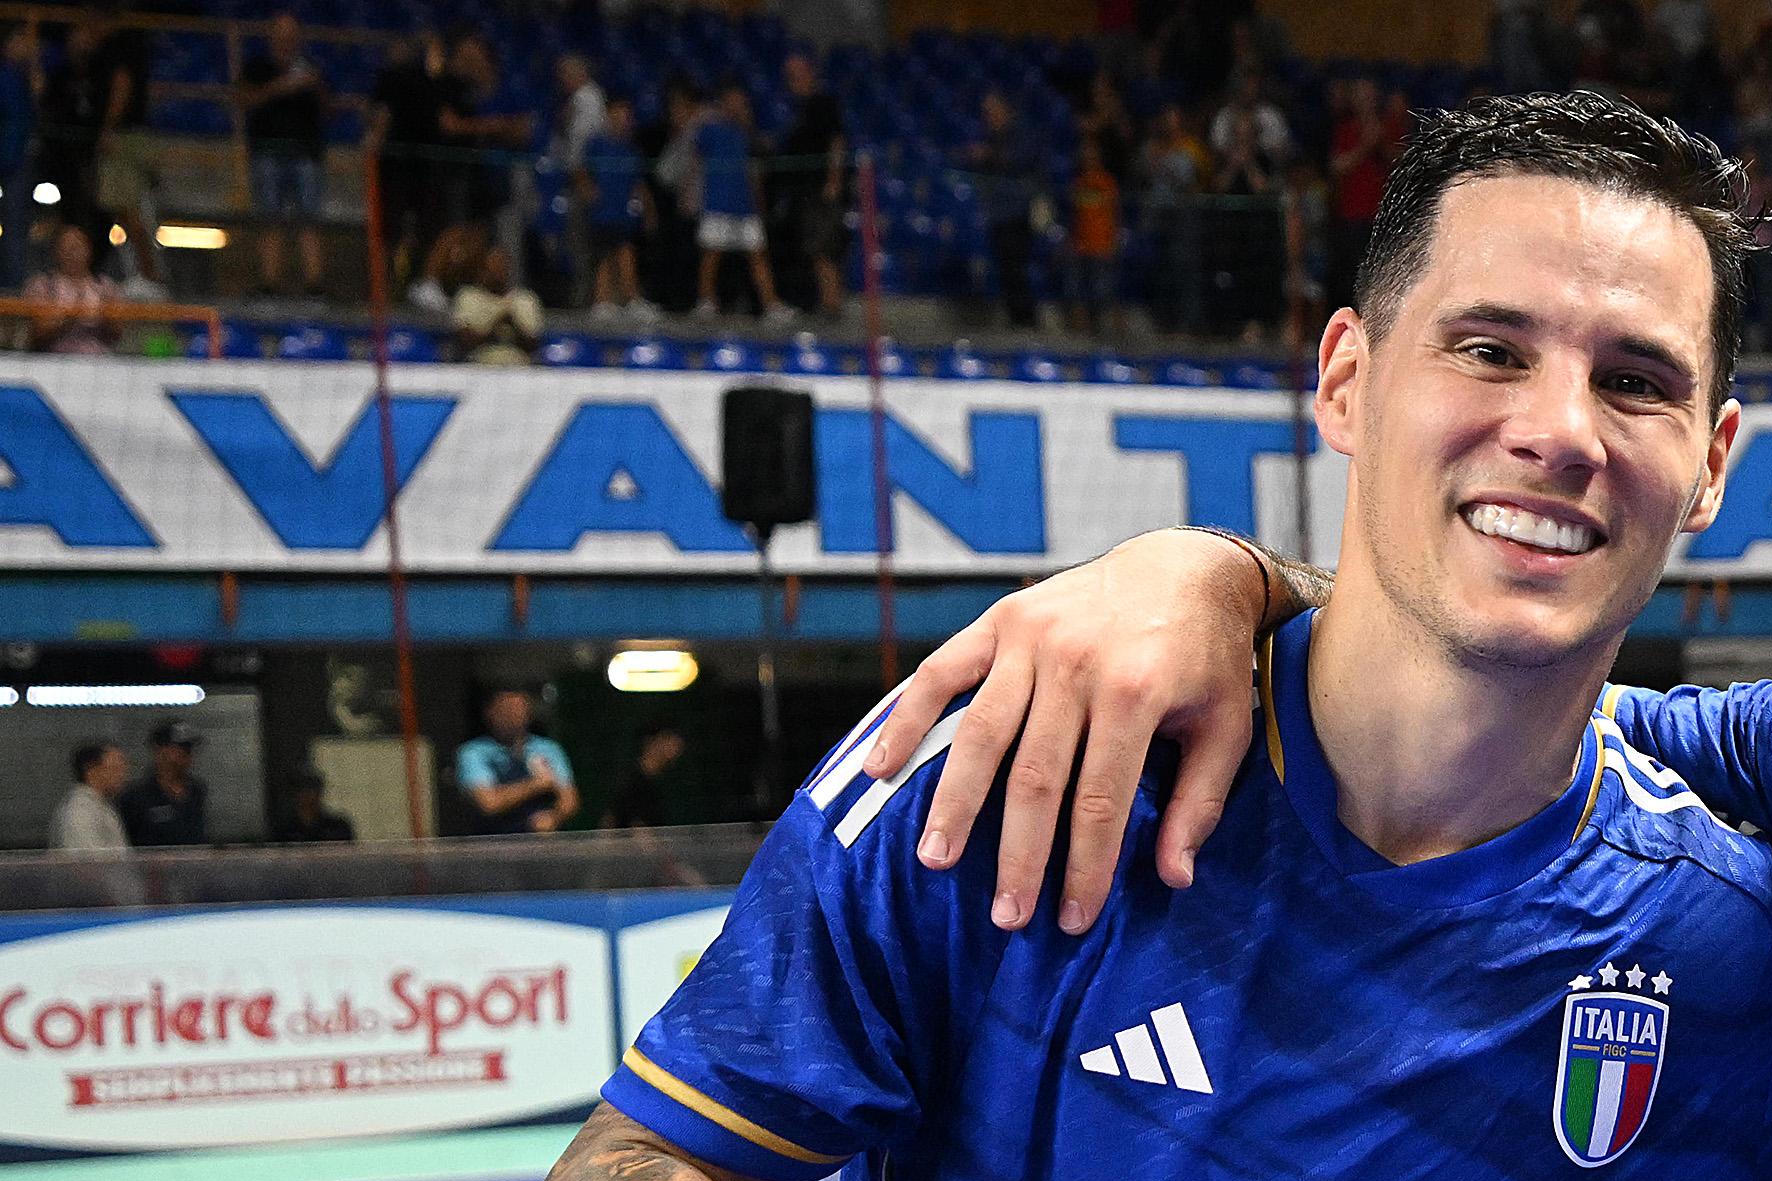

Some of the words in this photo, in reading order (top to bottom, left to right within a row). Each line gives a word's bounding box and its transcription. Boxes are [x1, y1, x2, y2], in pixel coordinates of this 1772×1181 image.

[0, 384, 1321, 553] AVANT
[0, 982, 276, 1052] Corriere
[390, 967, 570, 1055] Sport
[1573, 1006, 1657, 1046] ITALIA
[1602, 1043, 1627, 1057] FIGC
